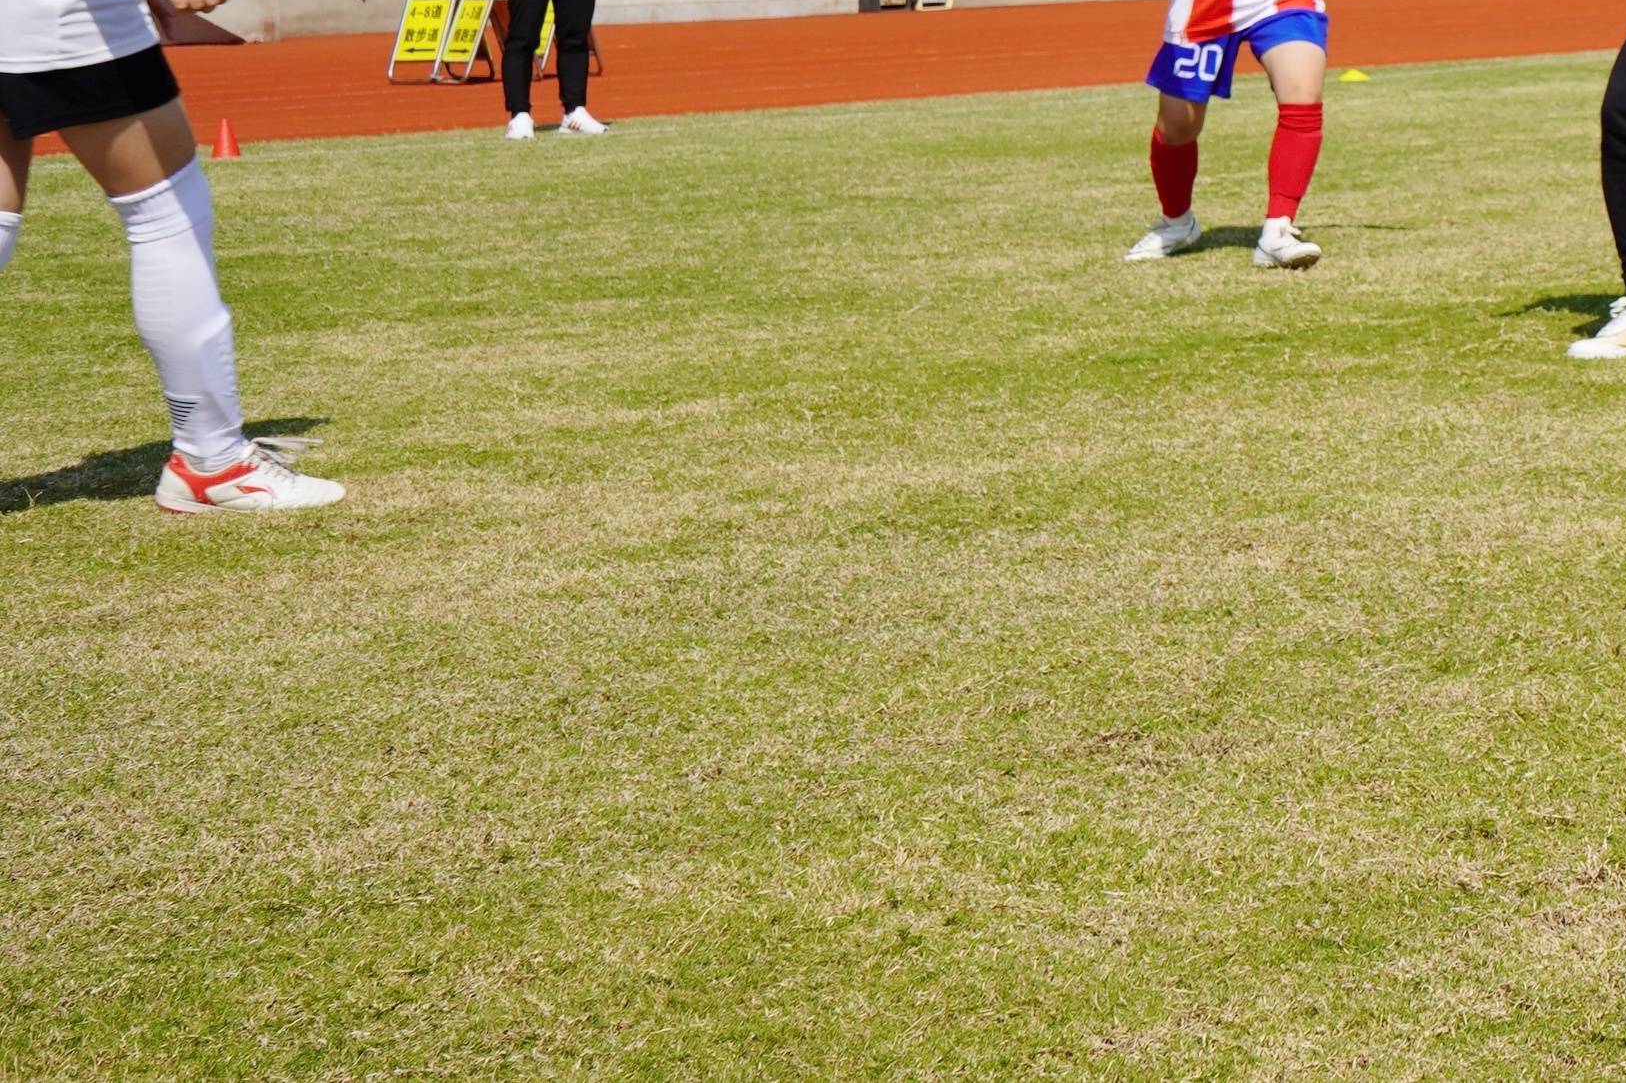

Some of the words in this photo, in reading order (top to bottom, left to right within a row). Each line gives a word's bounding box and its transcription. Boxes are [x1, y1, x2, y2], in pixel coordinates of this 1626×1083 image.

[404, 27, 439, 43] 散步道
[1173, 42, 1224, 82] 20
